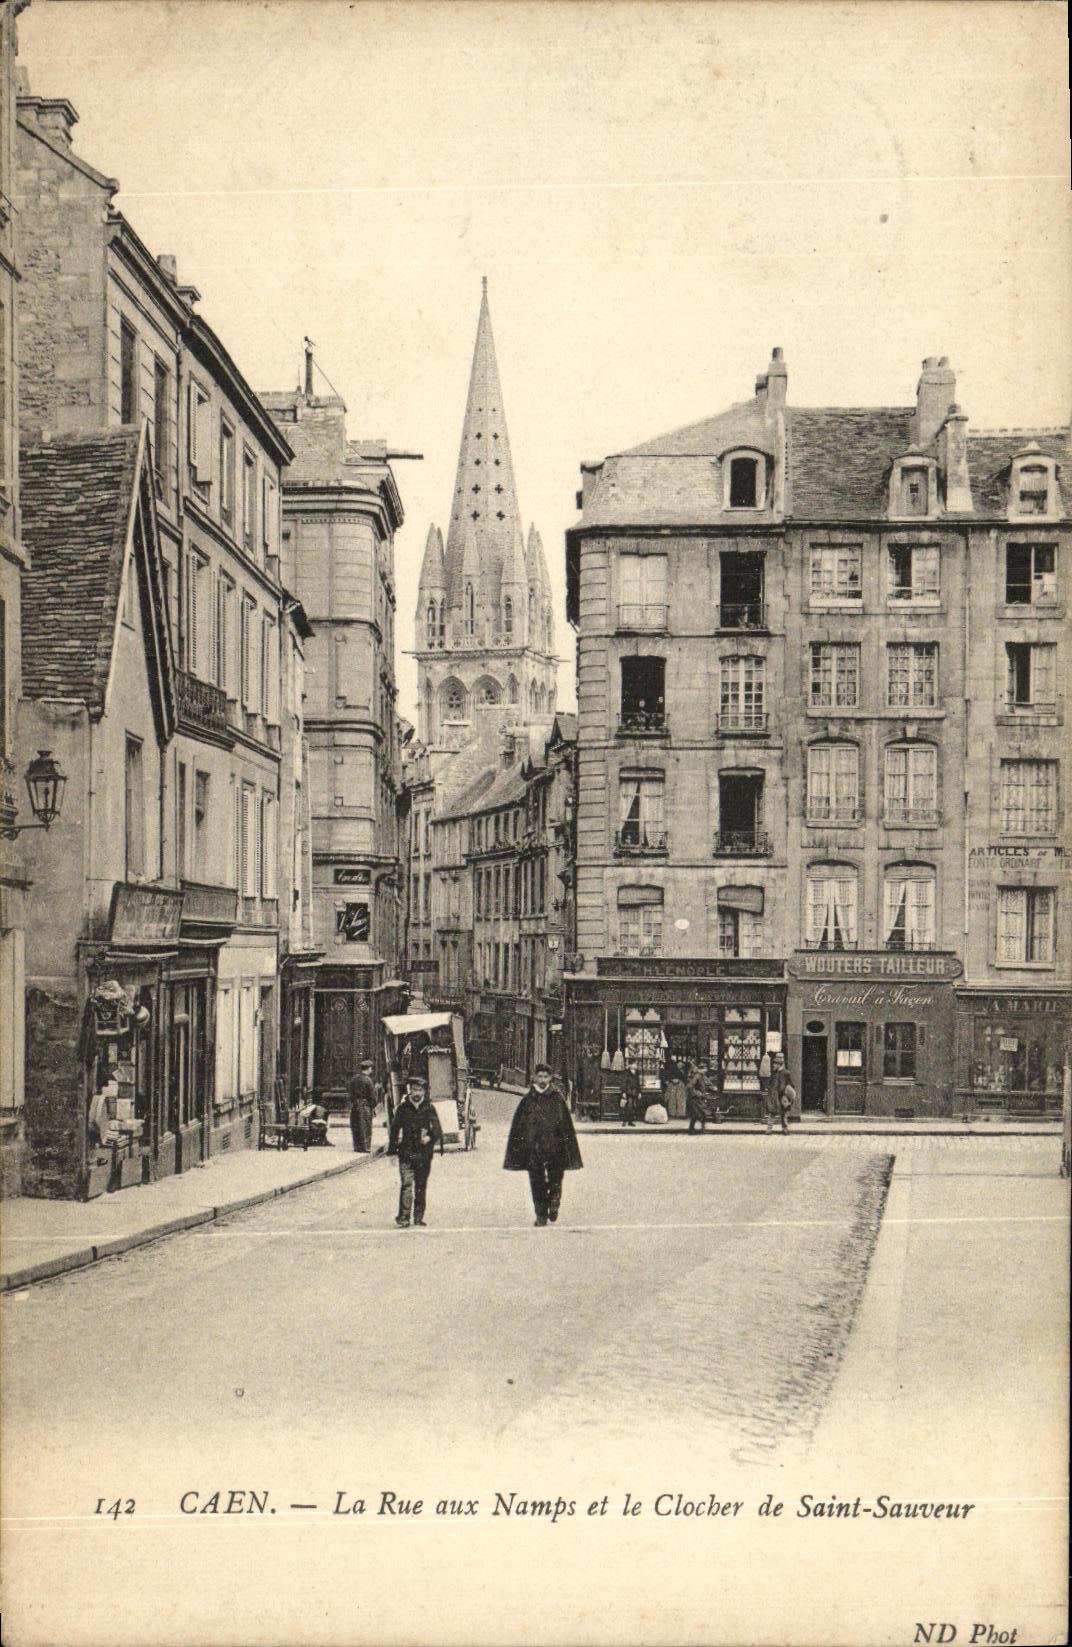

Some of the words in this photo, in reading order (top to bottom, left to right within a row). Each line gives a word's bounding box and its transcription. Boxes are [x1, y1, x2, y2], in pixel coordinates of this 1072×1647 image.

[969, 846, 1029, 857] ARTICLES
[804, 956, 872, 974] WOUTERS
[879, 957, 945, 975] TAILLEUR
